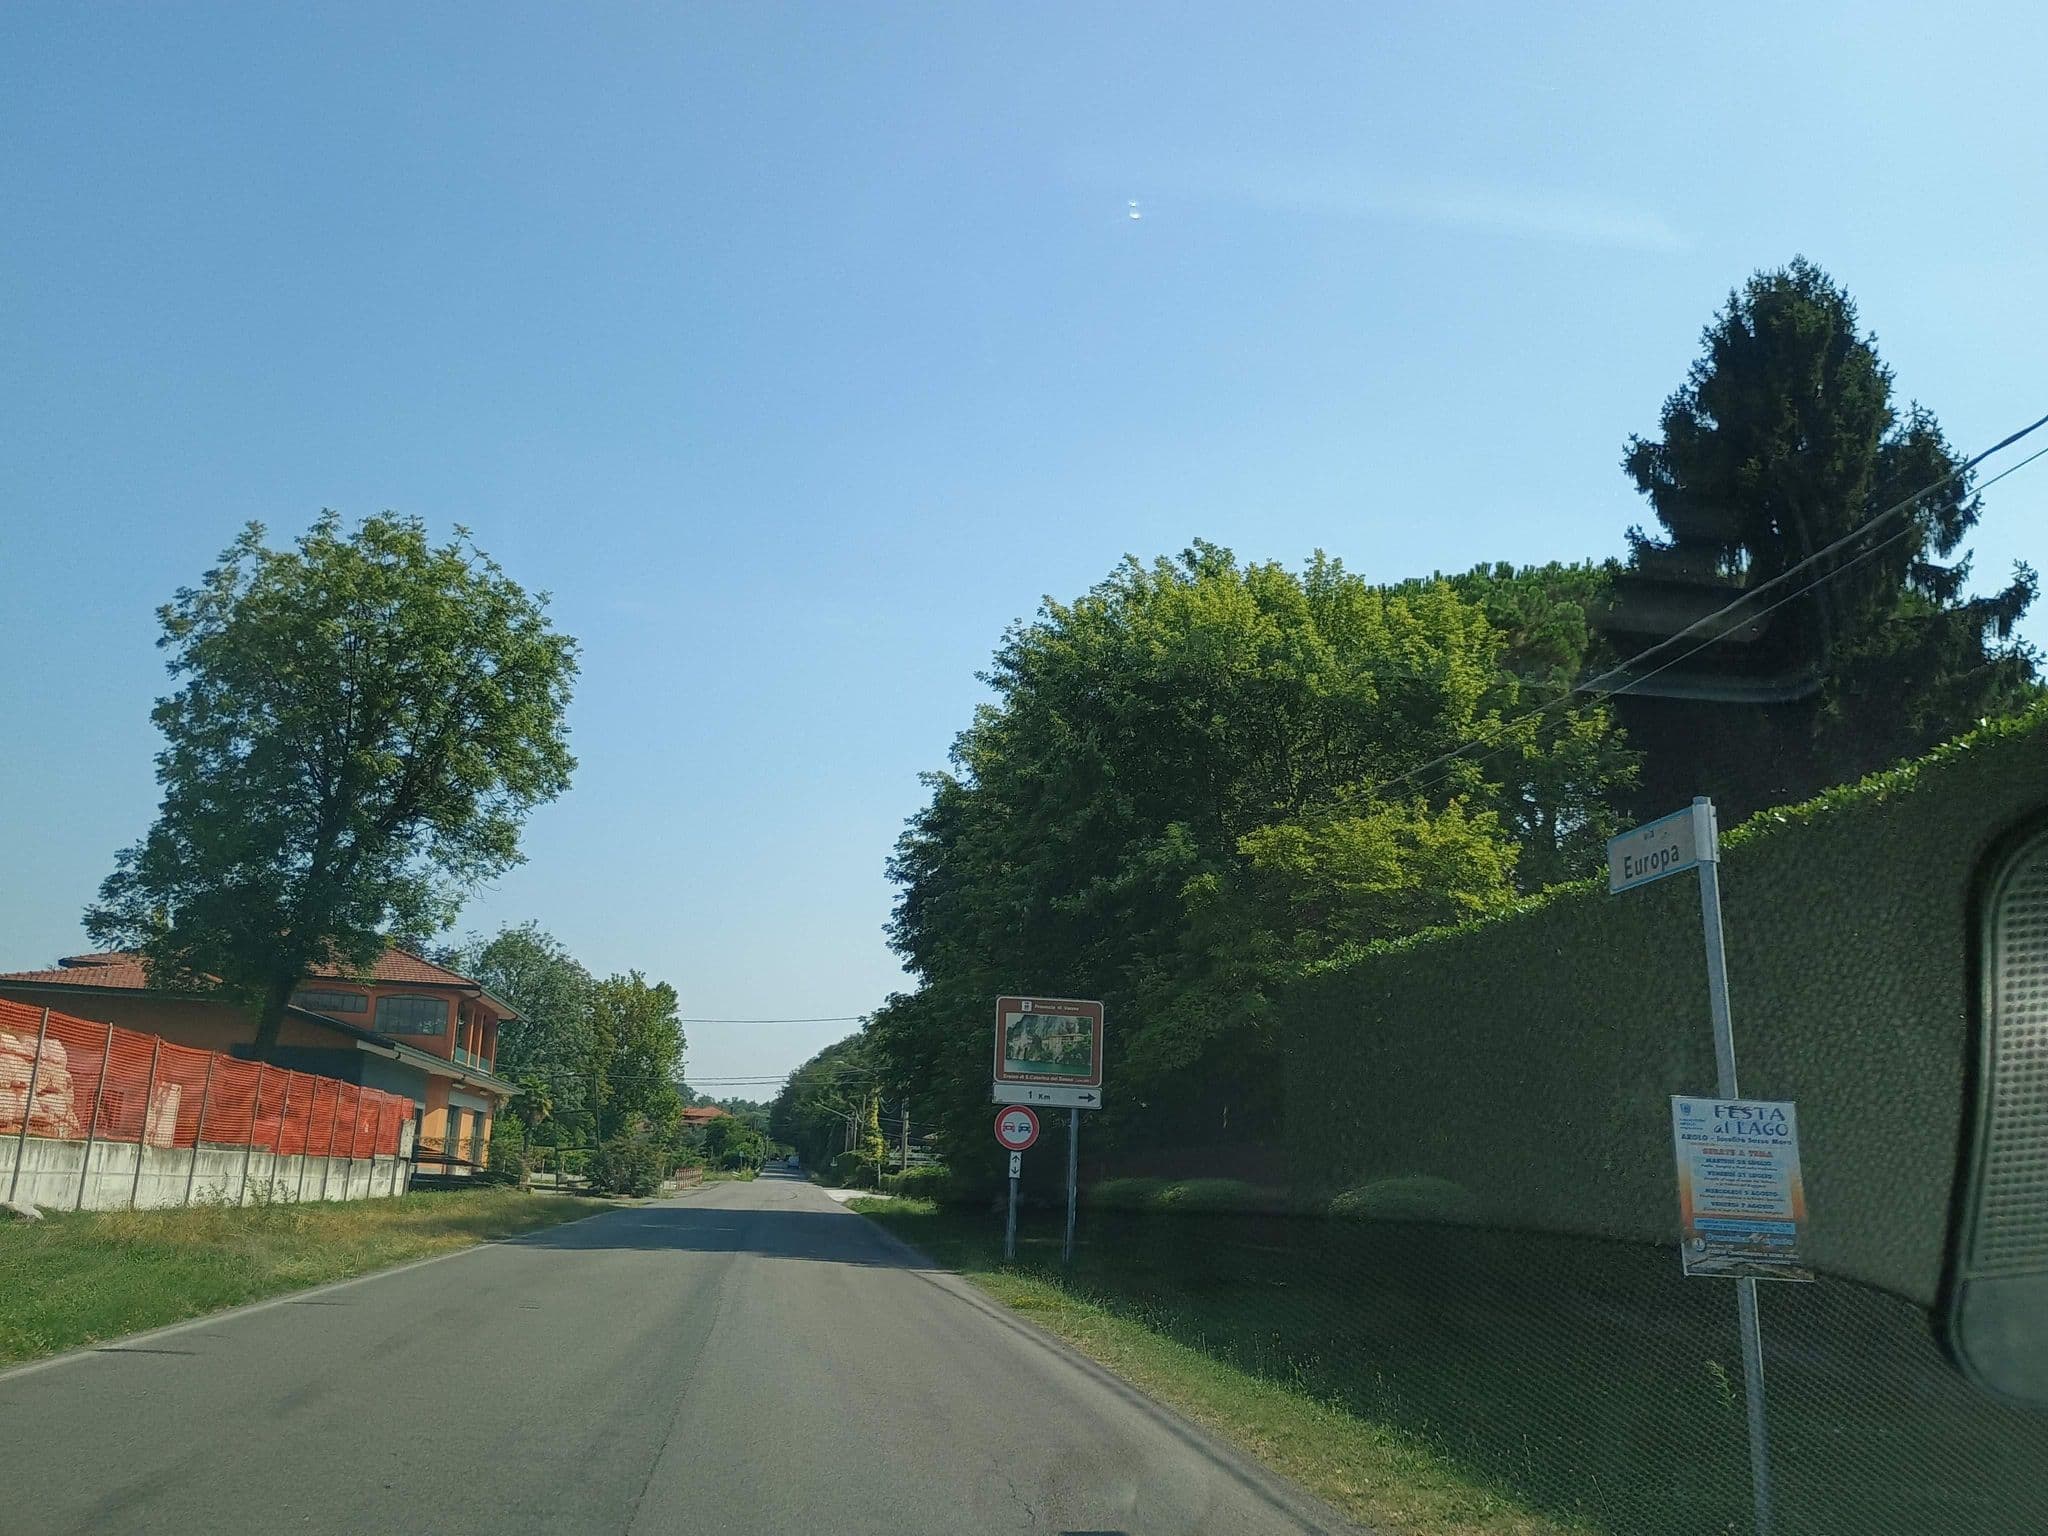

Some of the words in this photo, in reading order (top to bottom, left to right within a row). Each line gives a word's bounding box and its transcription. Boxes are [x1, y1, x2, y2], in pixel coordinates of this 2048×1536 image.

[1623, 844, 1680, 879] Europa
[1028, 1090, 1033, 1099] 1
[1714, 1104, 1786, 1121] FESTA
[1713, 1120, 1729, 1134] al
